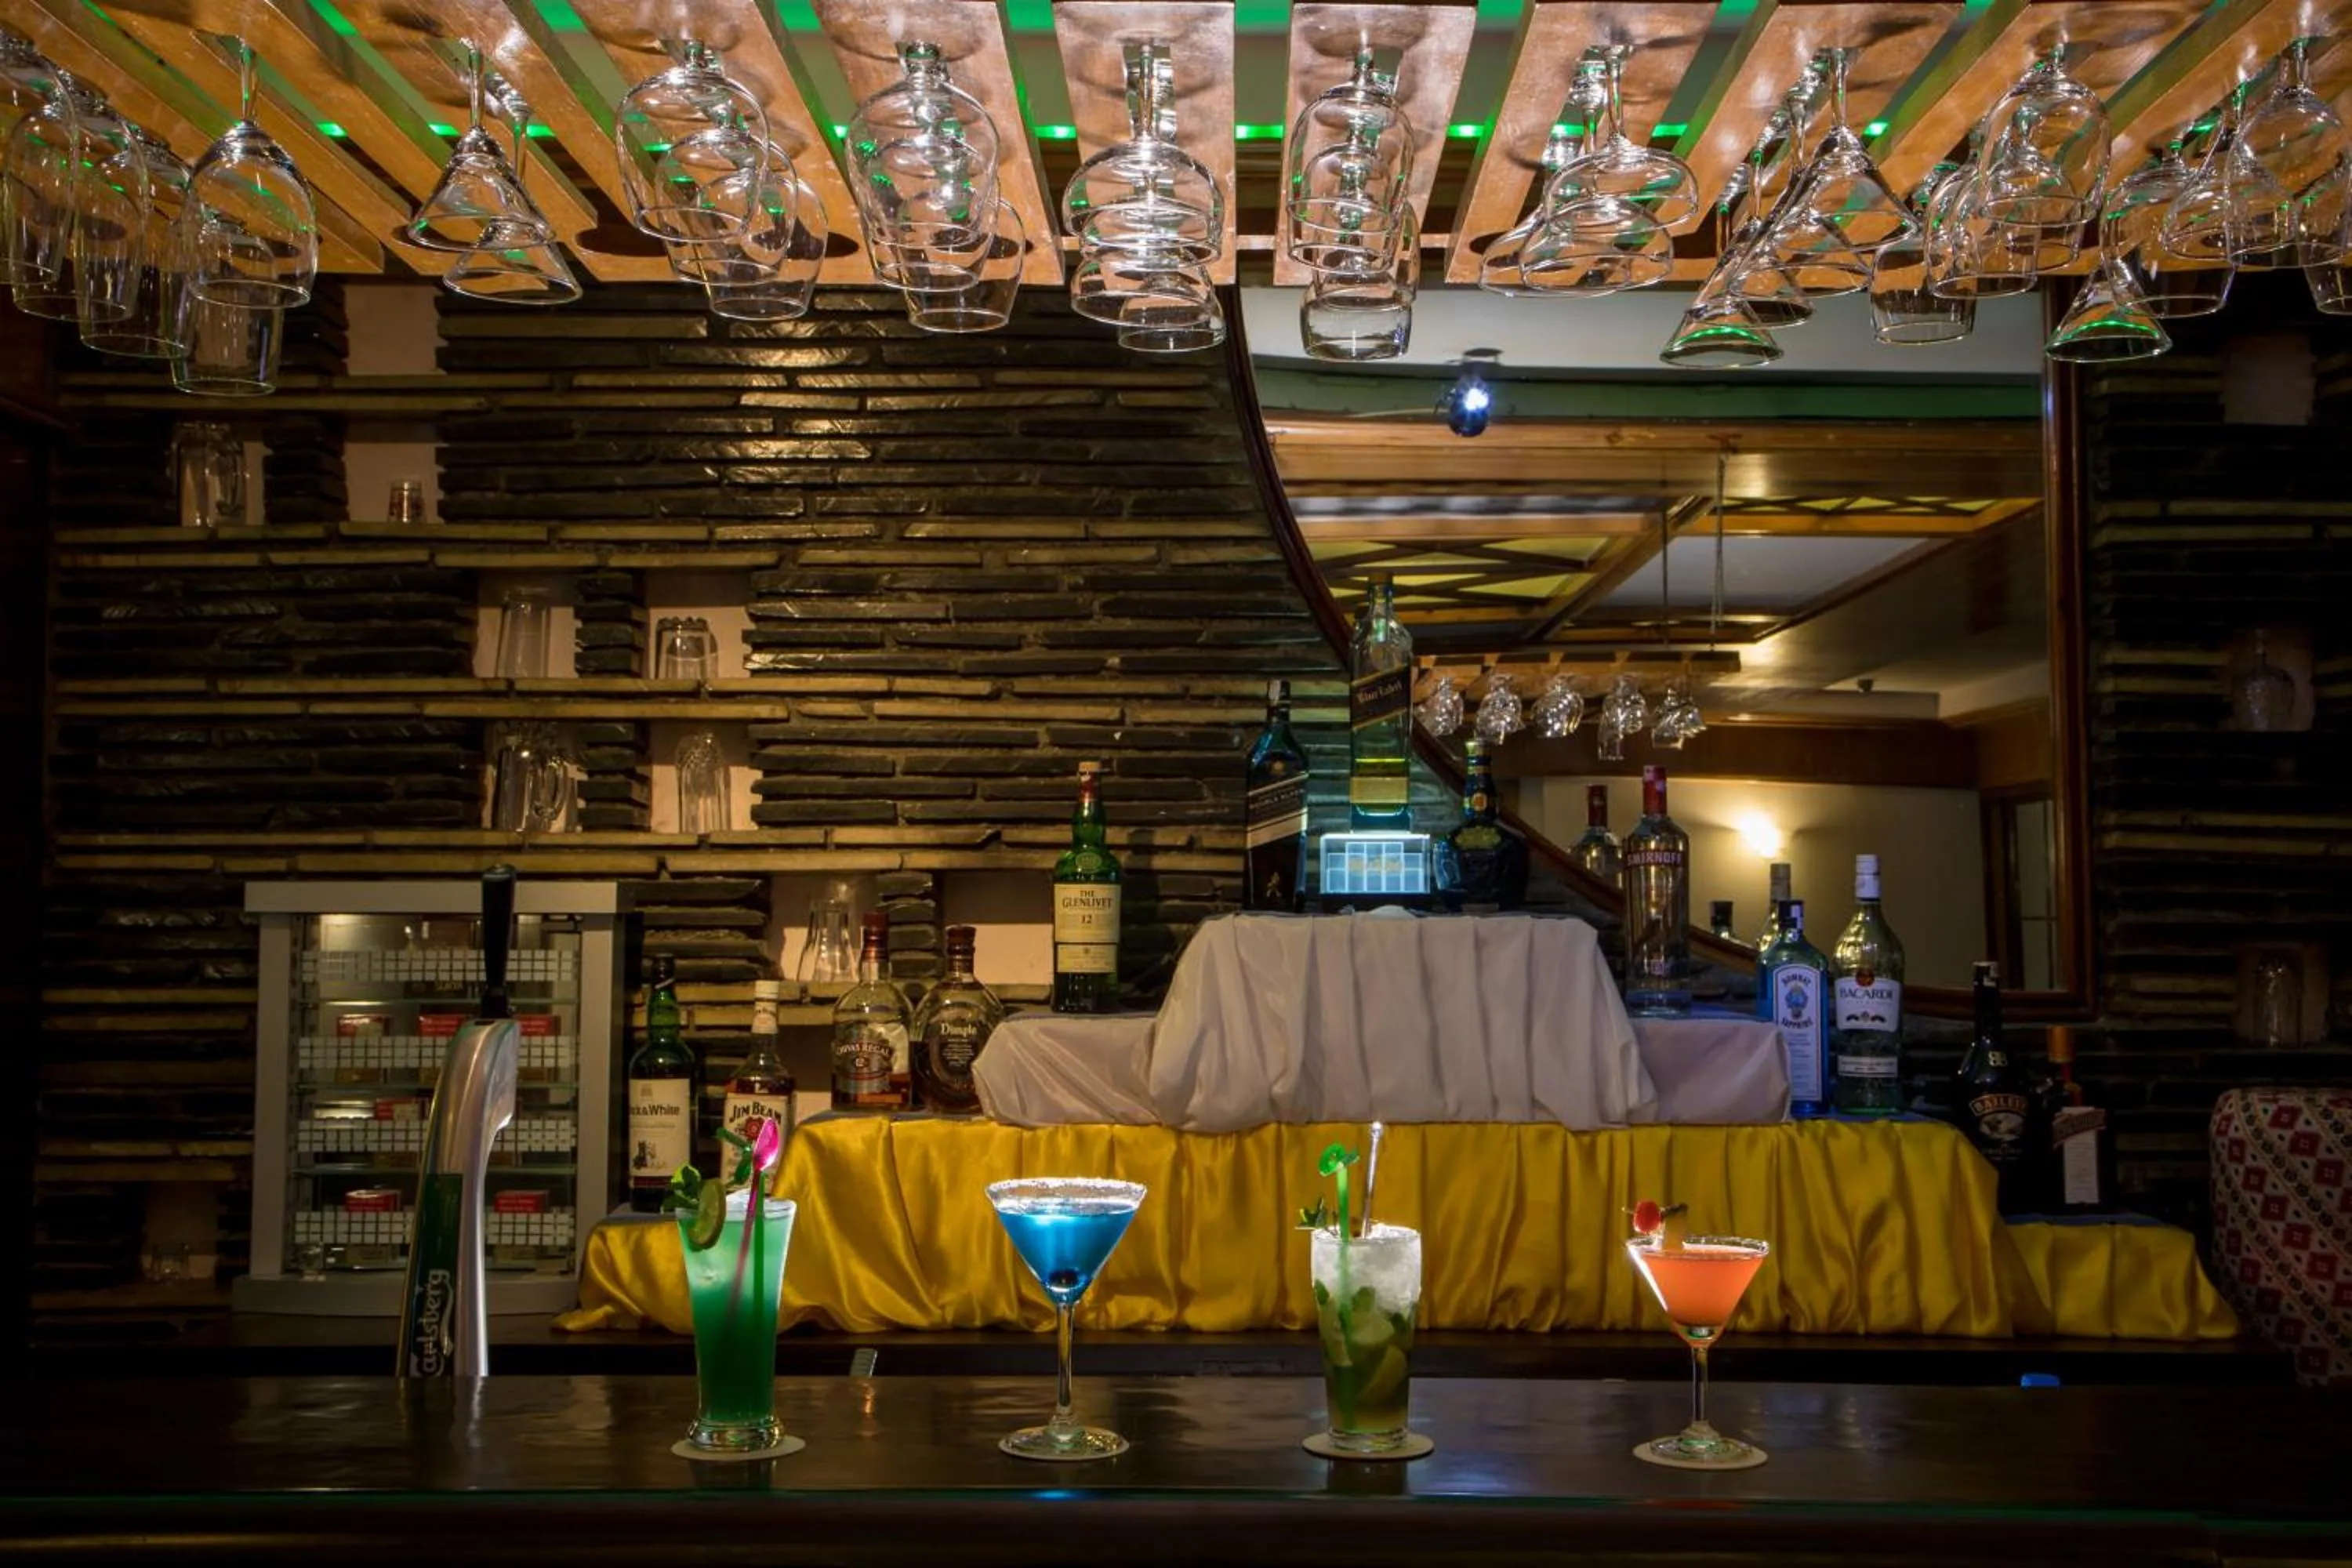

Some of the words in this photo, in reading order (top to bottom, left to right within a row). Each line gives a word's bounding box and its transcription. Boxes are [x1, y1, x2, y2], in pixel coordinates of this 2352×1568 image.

[1627, 851, 1682, 866] SMIRNOFF
[1062, 898, 1112, 909] GLENLIVET
[1081, 914, 1092, 924] 12
[1781, 973, 1811, 986] BOMBAY
[1839, 987, 1893, 1000] BACARDI
[1781, 1016, 1813, 1029] SAPPHIRE
[941, 1022, 978, 1037] Dimple
[836, 1044, 860, 1055] CHIVAS
[862, 1044, 891, 1056] REGAL
[730, 1105, 751, 1122] JIM
[752, 1102, 782, 1124] BEAM
